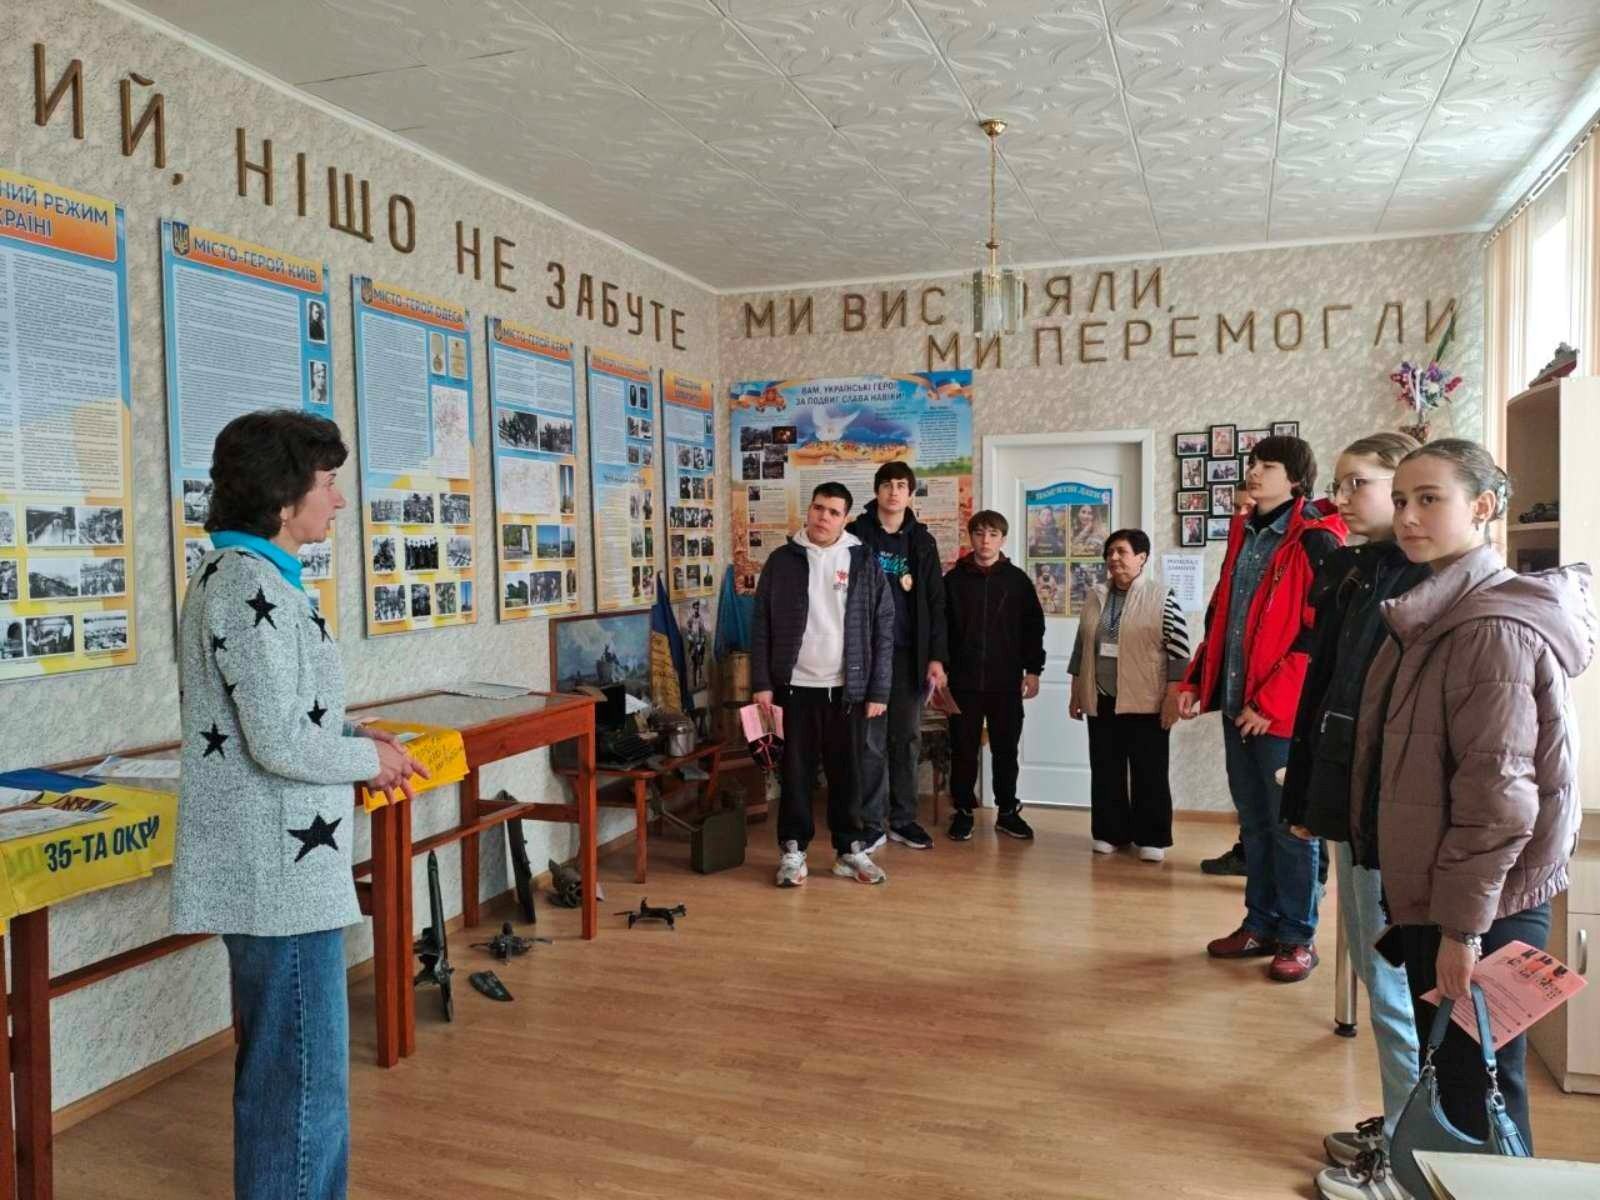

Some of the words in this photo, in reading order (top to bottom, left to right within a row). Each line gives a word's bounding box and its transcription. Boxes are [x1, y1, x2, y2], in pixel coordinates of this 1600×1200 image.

[44, 193, 108, 226] РЕЖИМ
[236, 127, 416, 254] НІЩО
[456, 220, 517, 293] НЕ
[547, 261, 688, 351] ЗАБУТЕ
[193, 237, 285, 274] МІСТО-ГЕРОЙ
[288, 263, 317, 284] КИЇВ
[373, 287, 434, 315] МІСТО-ГЕРОЙ
[744, 295, 814, 338] МИ
[928, 331, 1003, 372] МИ
[1034, 298, 1457, 366] ПЕРЕМОГЛИ
[842, 393, 869, 403] СЛАВА
[44, 832, 107, 872] 35-ТА
